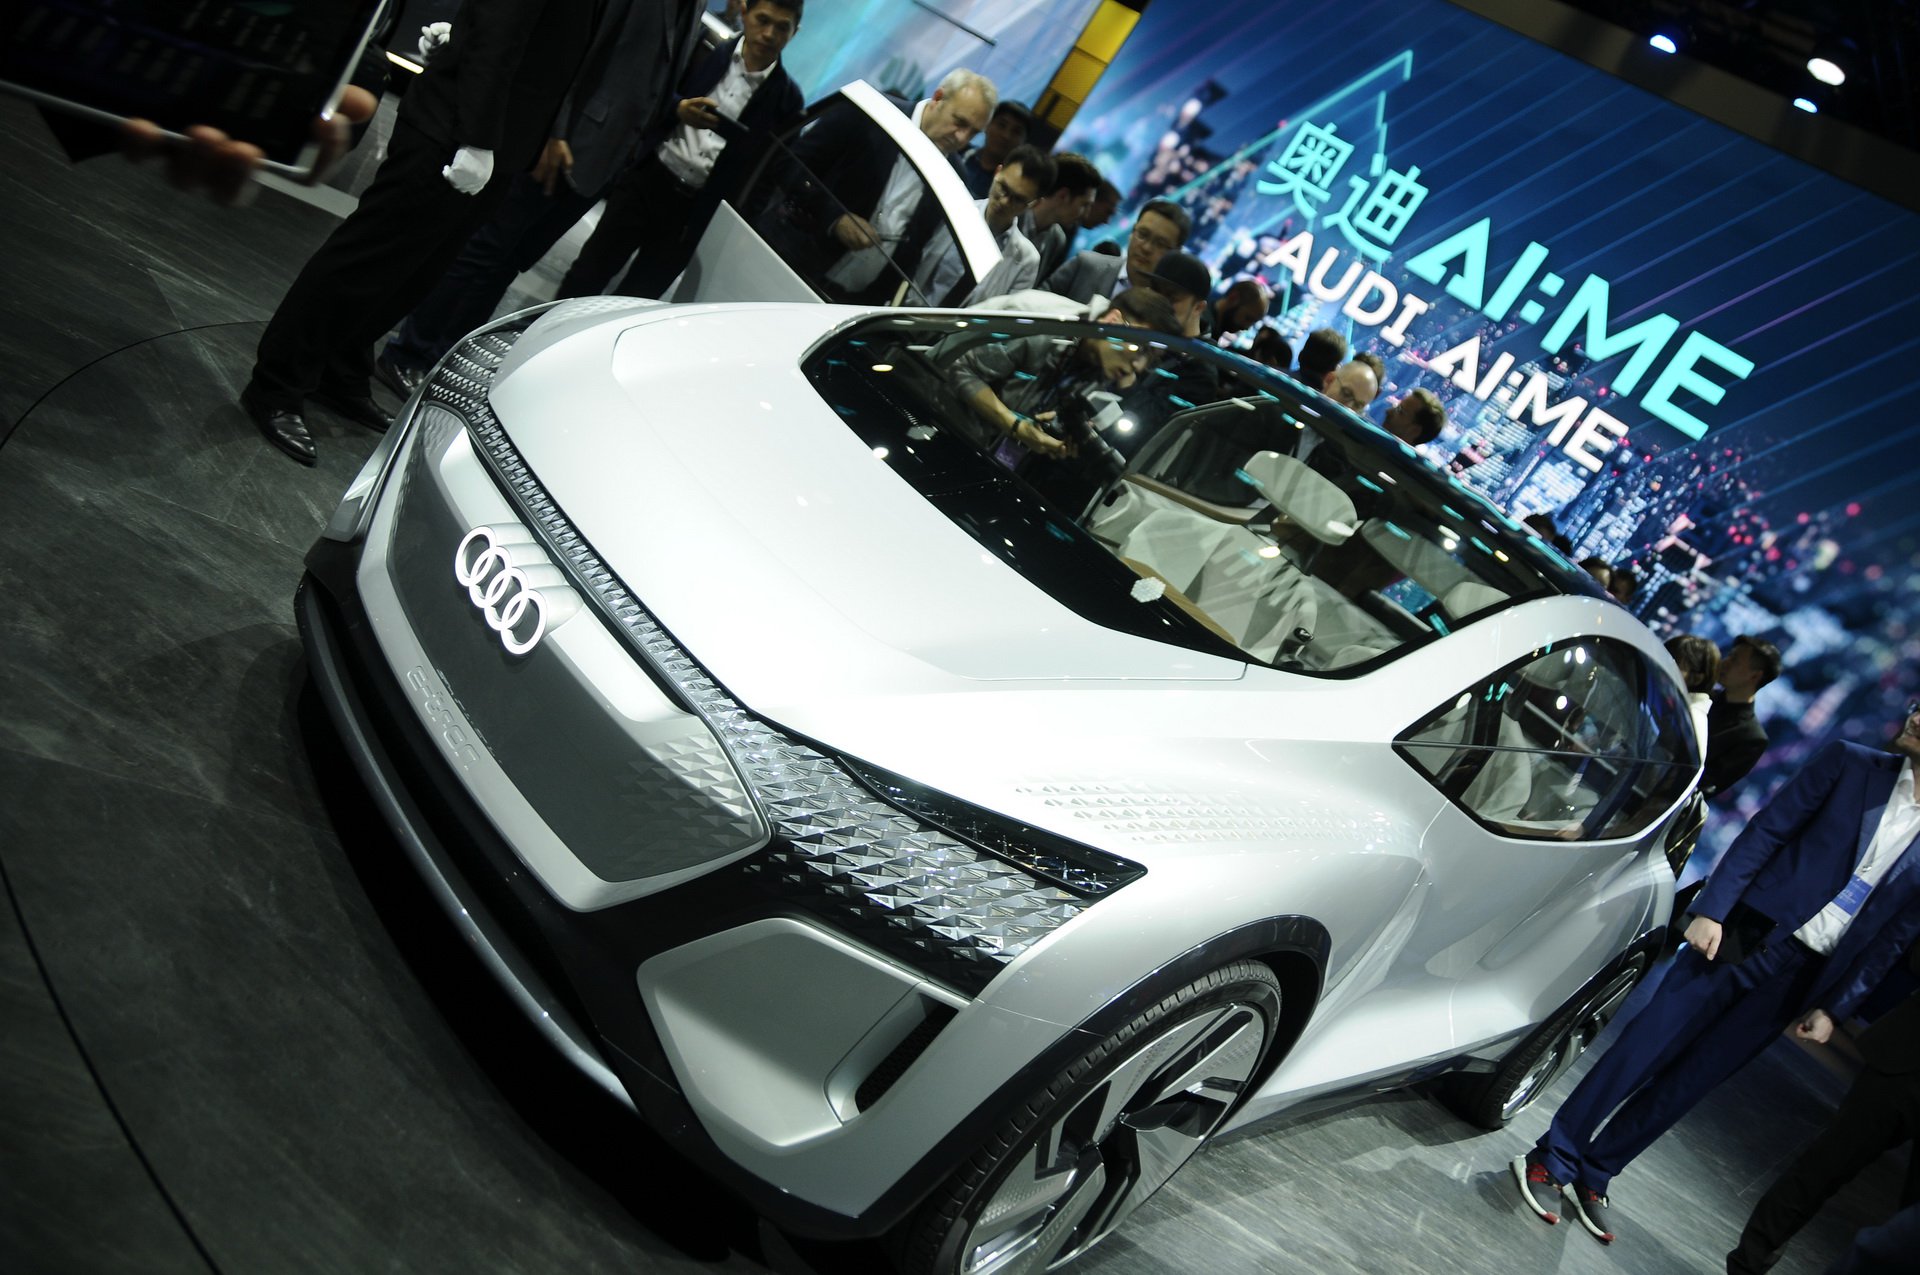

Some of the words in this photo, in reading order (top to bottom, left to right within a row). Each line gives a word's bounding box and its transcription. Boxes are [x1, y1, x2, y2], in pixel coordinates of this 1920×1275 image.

[1256, 120, 1429, 261] 奥迪
[1405, 217, 1755, 440] AI:ME
[1264, 231, 1429, 347] AUDI
[1428, 335, 1630, 473] AI:ME
